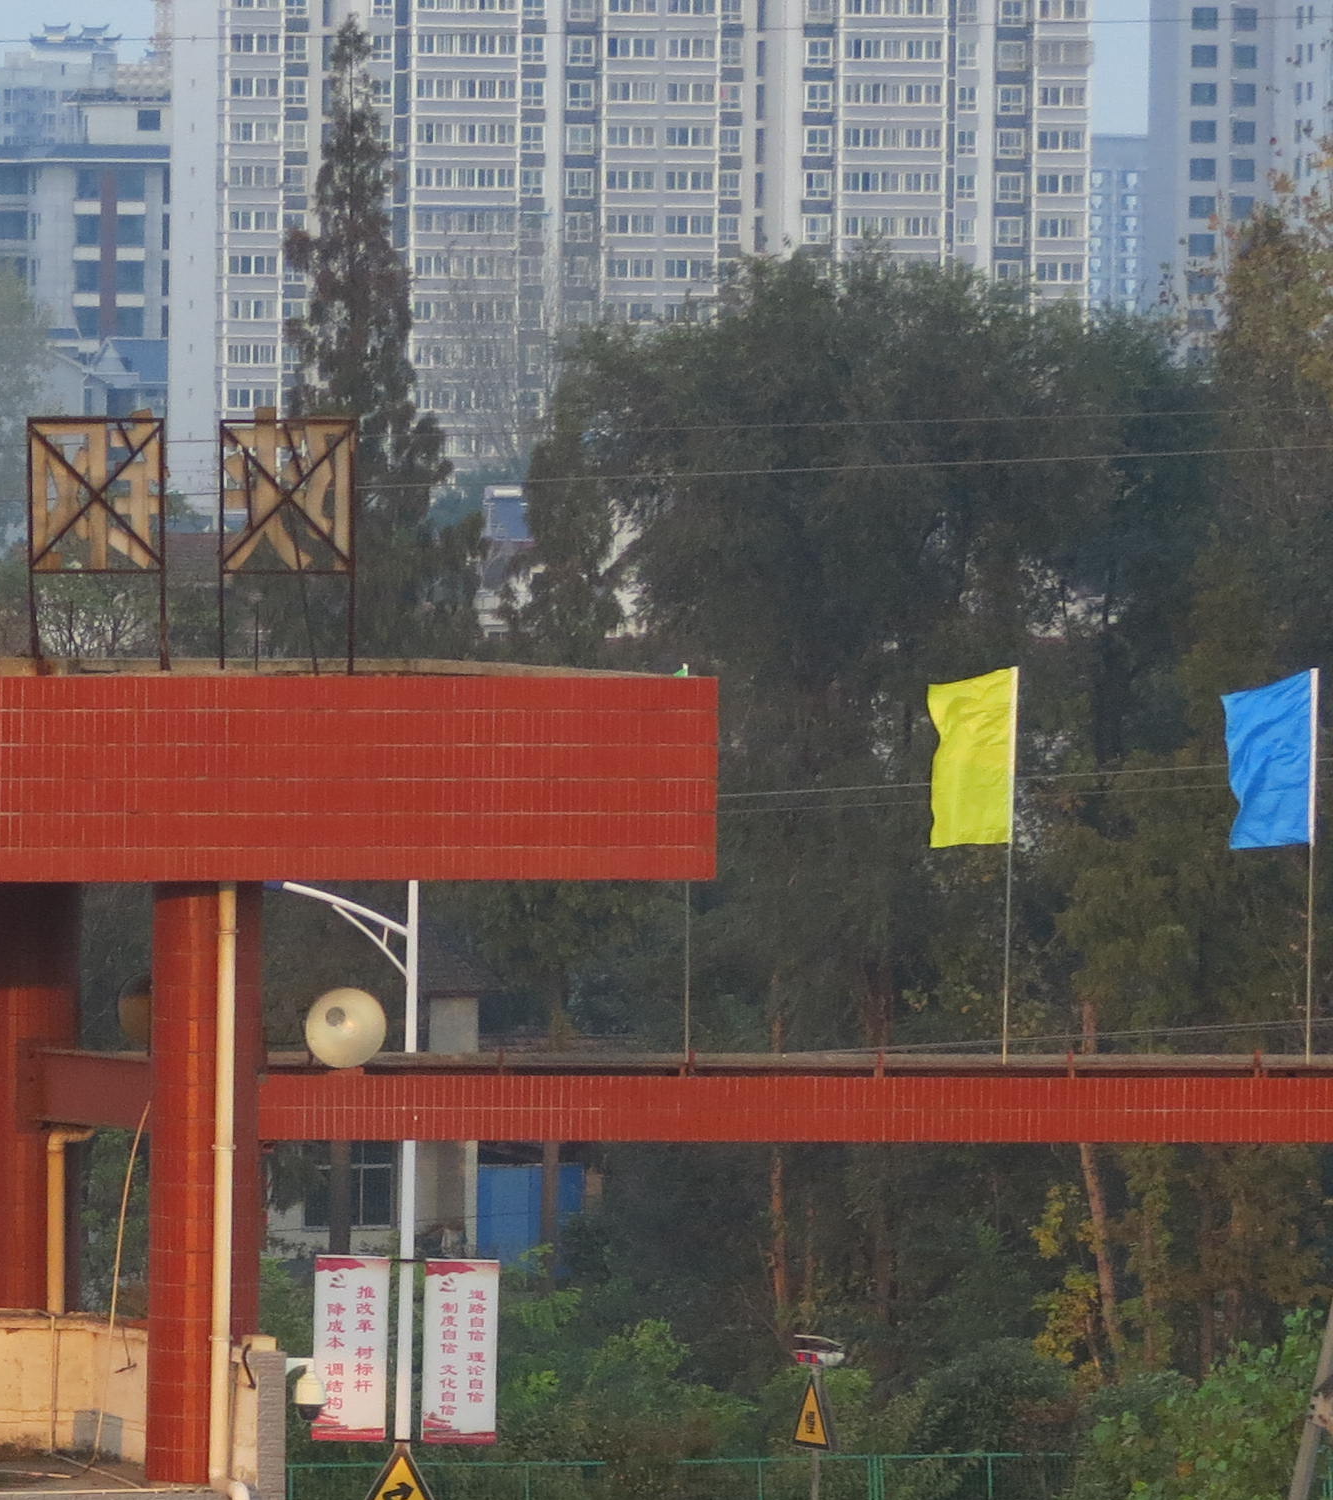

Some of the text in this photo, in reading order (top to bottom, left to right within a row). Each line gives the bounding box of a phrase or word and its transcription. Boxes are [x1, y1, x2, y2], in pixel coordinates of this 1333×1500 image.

[325, 1303, 346, 1410] 降成本 调结构
[353, 1285, 376, 1393] 推改革 树标杆
[439, 1302, 459, 1416] 制度自信 文化自信
[466, 1290, 487, 1403] 道路自信 理论自信
